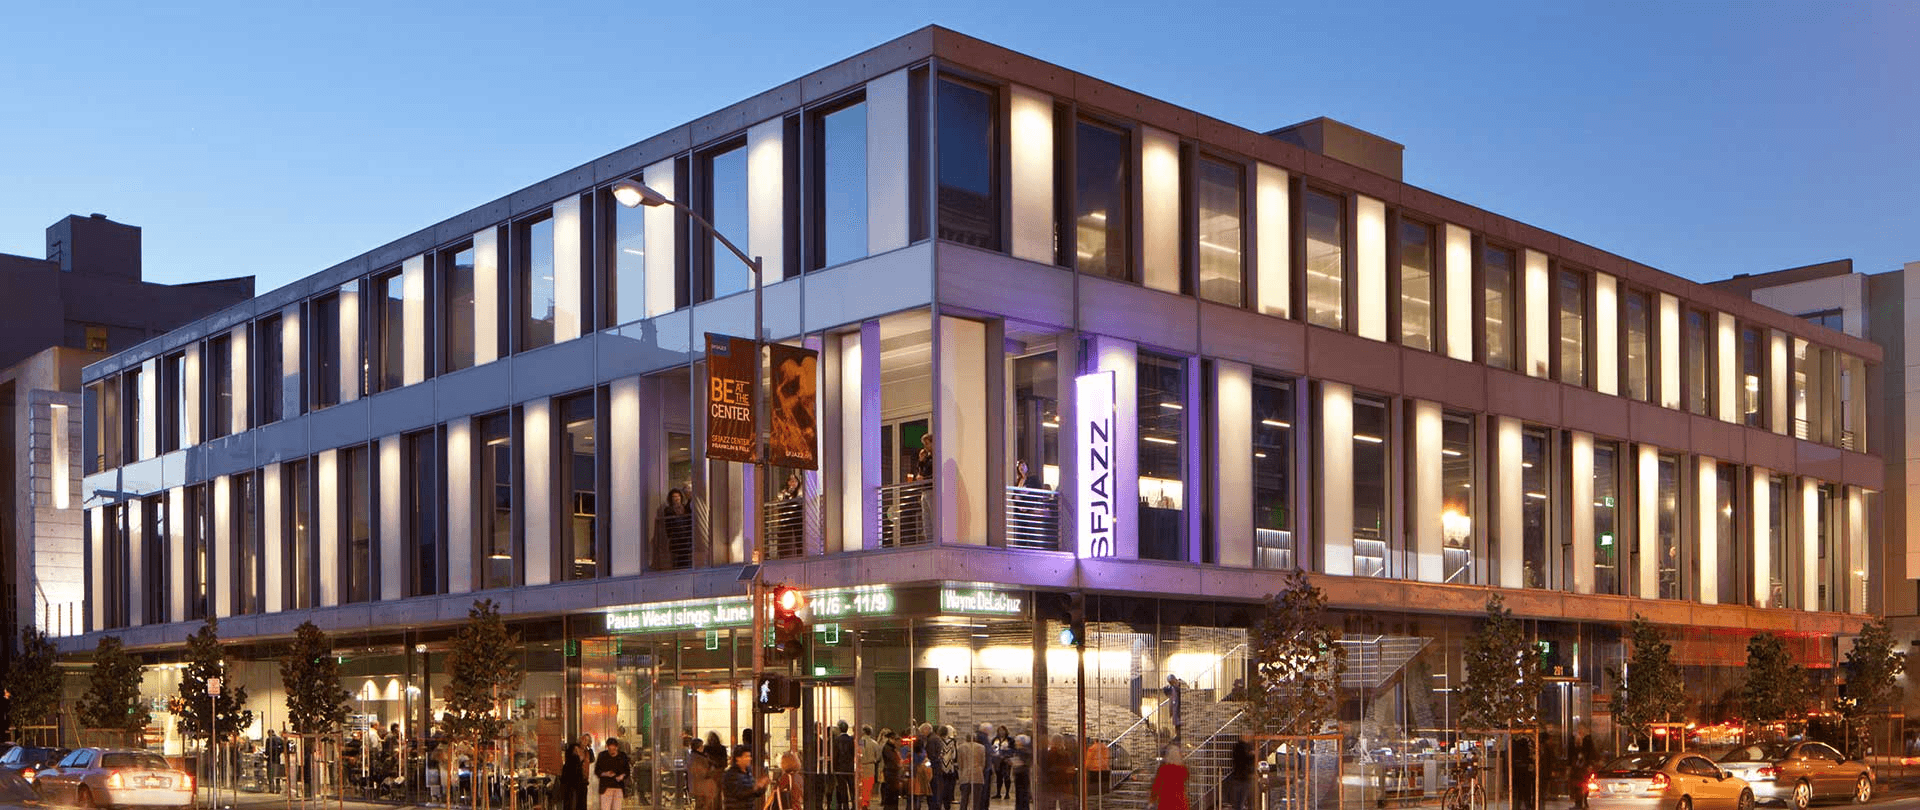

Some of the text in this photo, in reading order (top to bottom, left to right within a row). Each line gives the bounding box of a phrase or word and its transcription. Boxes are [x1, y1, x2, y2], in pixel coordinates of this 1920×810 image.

[711, 378, 744, 403] BE AT
[735, 394, 749, 404] THE
[711, 404, 750, 422] CENTER
[1090, 418, 1109, 558] SFJAZZ
[810, 596, 841, 616] 11/6
[854, 592, 887, 613] 11/9
[946, 589, 976, 612] Wayne
[607, 613, 639, 629] Paula
[642, 609, 673, 627] West
[676, 607, 711, 629] sings
[713, 605, 748, 622] June
